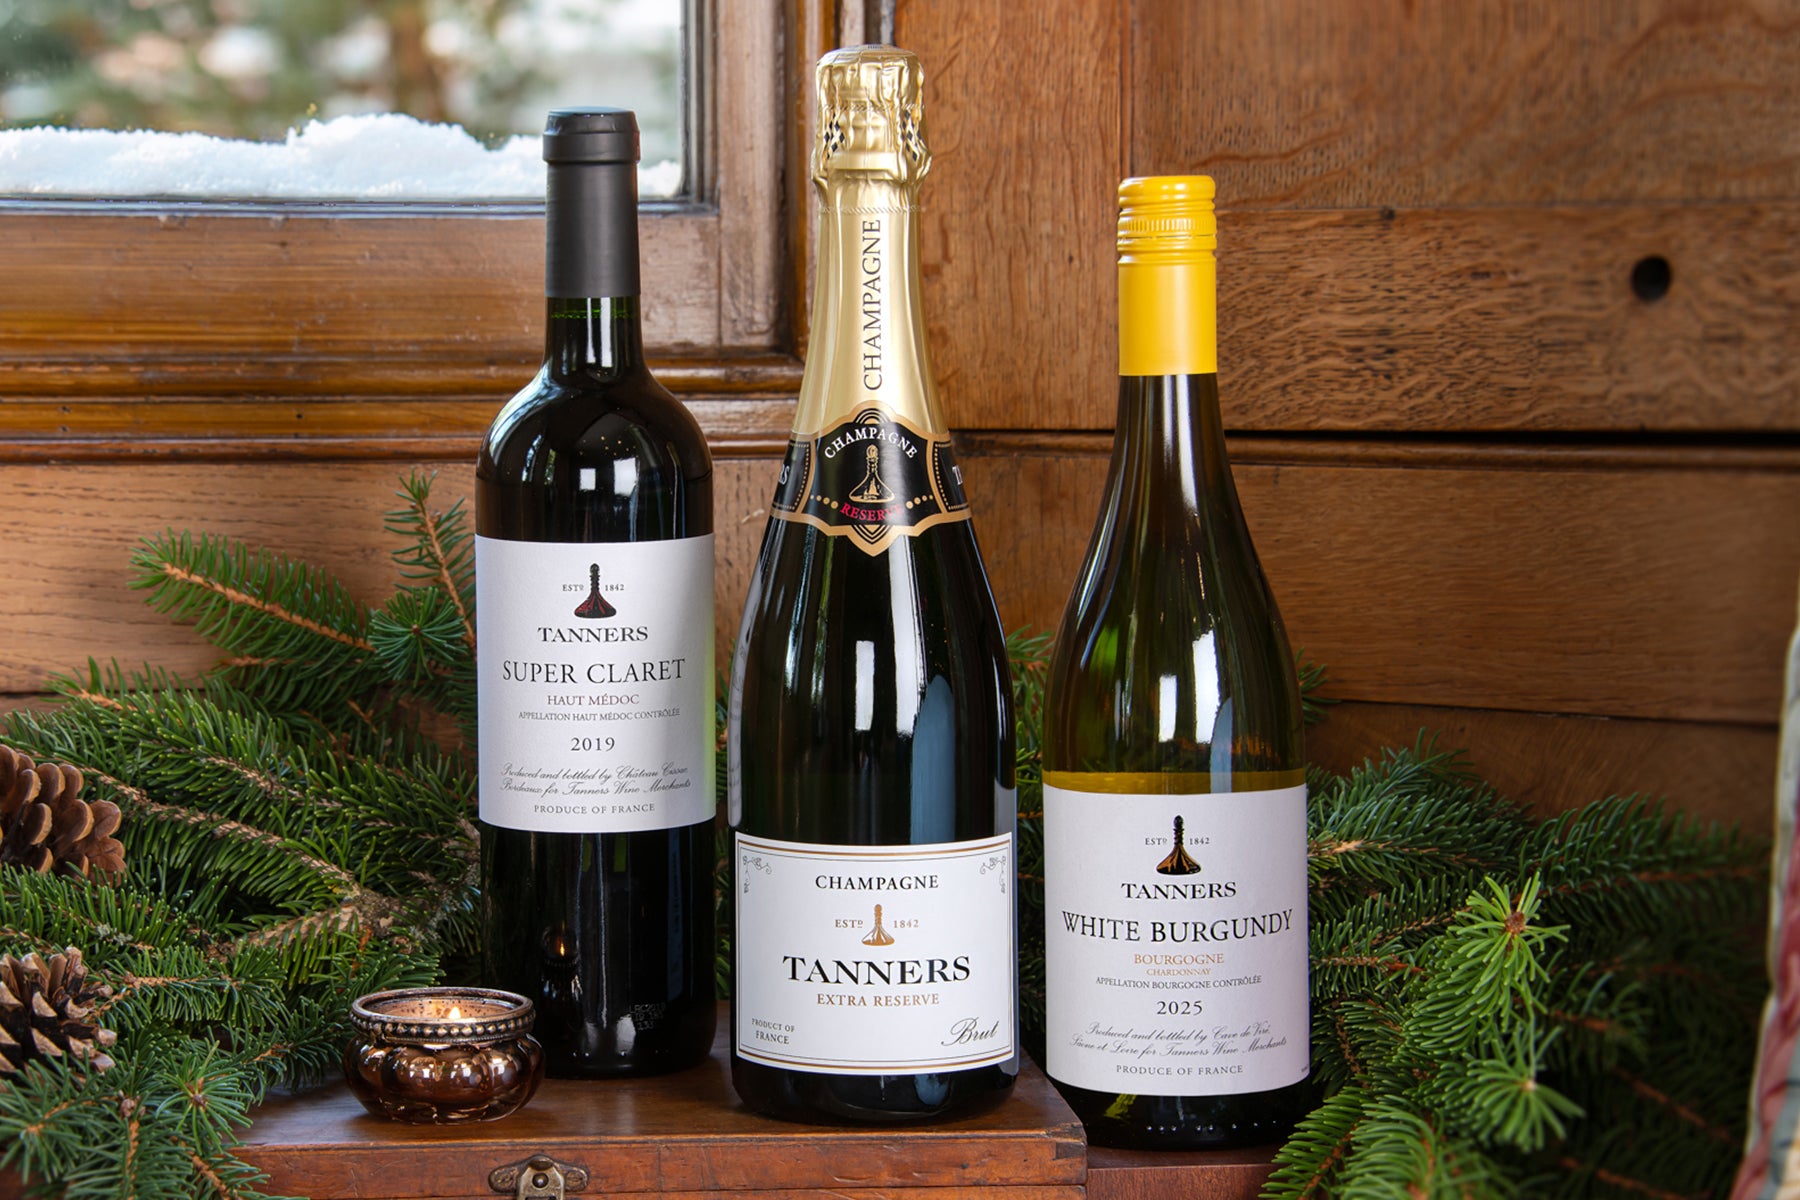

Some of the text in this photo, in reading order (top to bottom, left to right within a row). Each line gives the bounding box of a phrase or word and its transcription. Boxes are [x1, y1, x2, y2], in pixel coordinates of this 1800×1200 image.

[862, 219, 883, 391] CHAMPAGNE
[824, 427, 918, 459] CHAMPAGNE
[605, 583, 625, 592] 1842
[538, 626, 648, 643] TANNERS
[502, 658, 686, 684] SUPER CLARET
[547, 693, 640, 706] HAUT MÉDOC
[518, 711, 572, 721] APPELLATION
[572, 713, 598, 721] HAUT
[600, 711, 634, 721] MÉDOC
[570, 737, 615, 752] 2019
[501, 762, 542, 779] Produced
[540, 768, 564, 779] and
[562, 768, 600, 780] bottled
[598, 768, 612, 785] by
[541, 782, 559, 798] for
[562, 781, 609, 795] Tanners
[613, 780, 640, 794] Wine
[643, 778, 691, 792] Merchants
[534, 803, 655, 815] PRODUCE OF FRANCE
[1189, 836, 1210, 845] 1842
[815, 874, 939, 891] CHAMPAGNE
[1121, 882, 1237, 900] TANNERS
[893, 919, 919, 929] 1842
[1062, 908, 1293, 943] WHITE BURGUNDY
[1134, 953, 1225, 965] BOURGOGNE
[783, 956, 970, 985] TANNERS
[1146, 968, 1211, 976] CHARDONNAY
[1096, 976, 1150, 989] APPELLATION
[1152, 981, 1211, 989] BOURGOGNE
[817, 993, 939, 1007] EXTRA RESERVE
[1156, 1000, 1203, 1015] 2025
[751, 1018, 795, 1033] PRODUCT OF
[940, 1016, 1000, 1046] Brut
[755, 1030, 789, 1045] FRANCE
[1085, 1021, 1133, 1039] Produced
[1131, 1029, 1157, 1040] and
[1155, 1029, 1196, 1040] bottled
[1193, 1029, 1207, 1046] by
[1137, 1043, 1156, 1059] for
[1159, 1042, 1209, 1056] Tanners
[1212, 1041, 1239, 1055] Wine
[1242, 1036, 1287, 1053] Merchants
[1116, 1064, 1243, 1076] PRODUCE OF FRANCE
